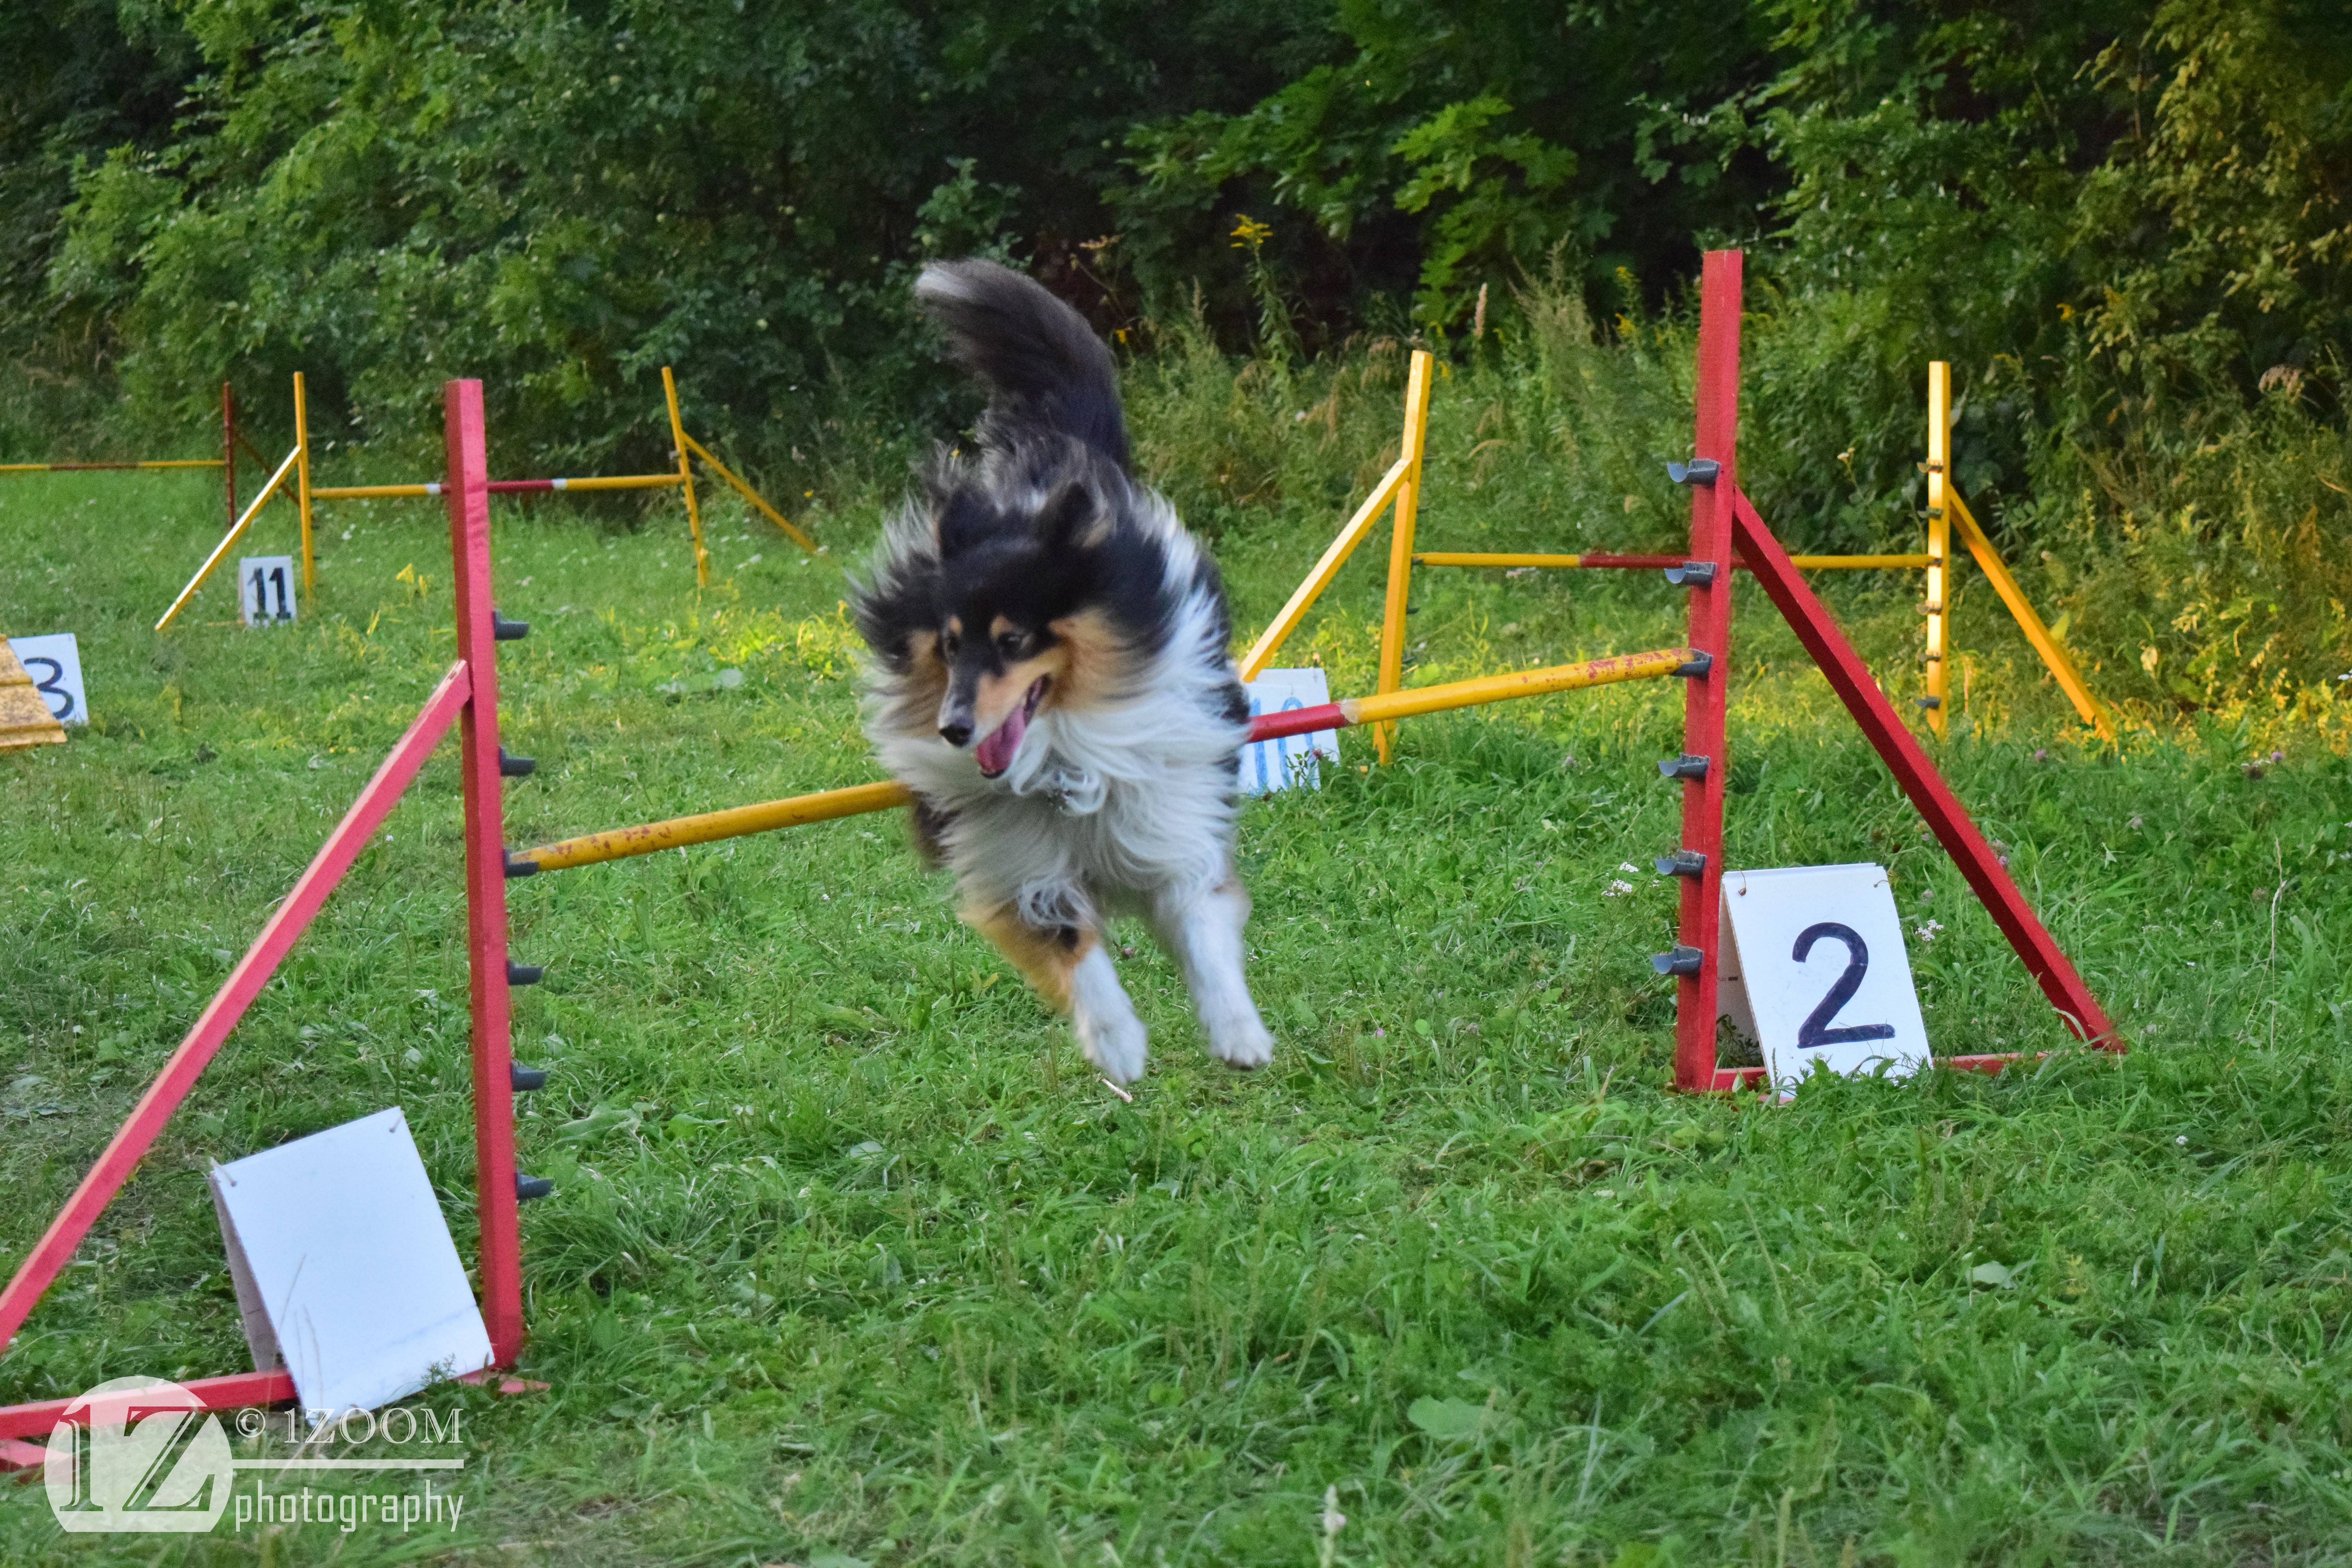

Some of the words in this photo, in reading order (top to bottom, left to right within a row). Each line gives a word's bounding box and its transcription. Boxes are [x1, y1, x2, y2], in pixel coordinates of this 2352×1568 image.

[247, 566, 292, 620] 11
[24, 657, 75, 720] 3
[1792, 921, 1896, 1049] 2
